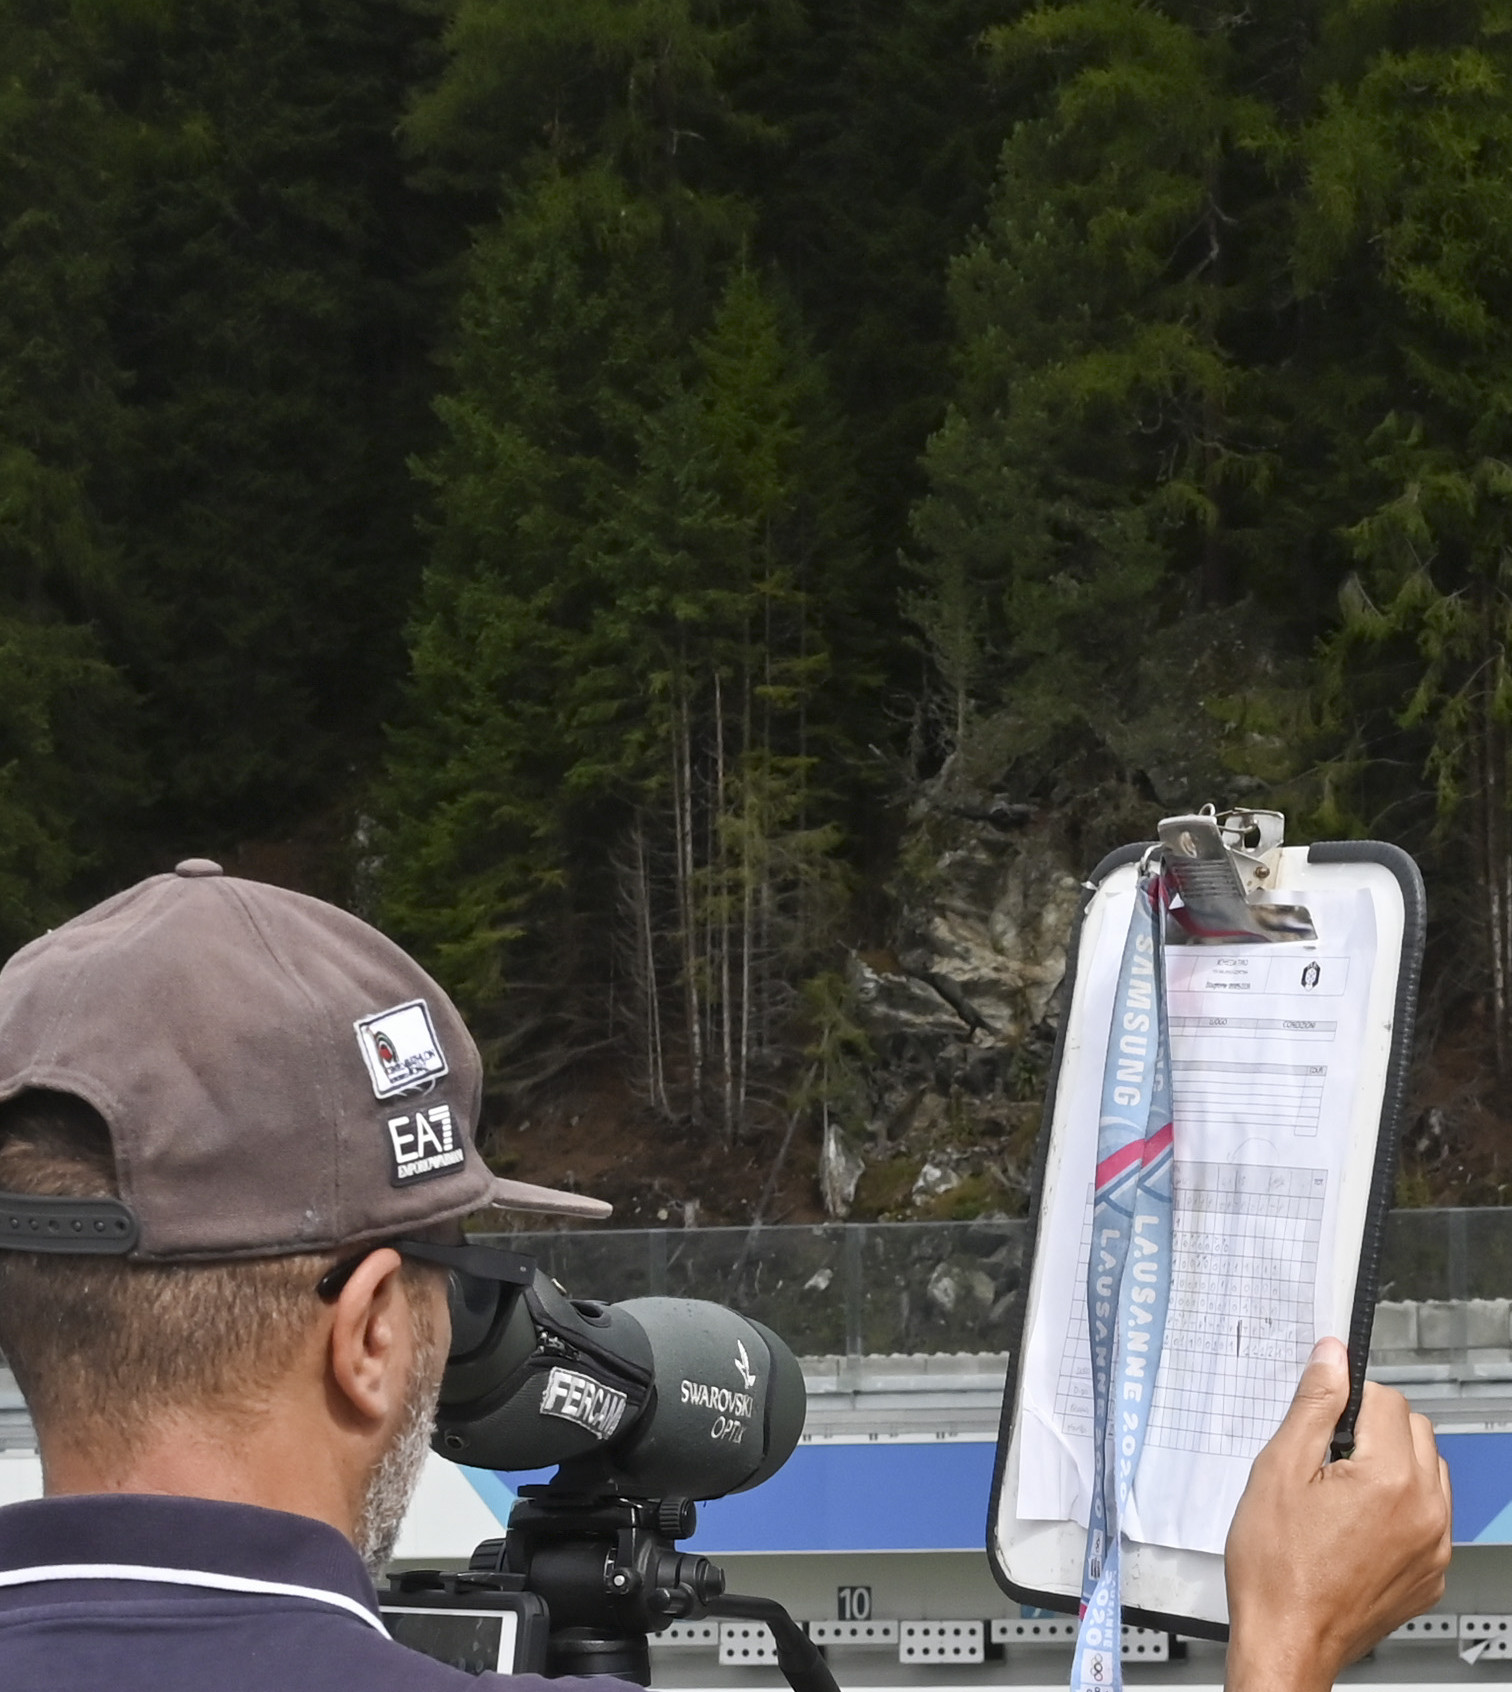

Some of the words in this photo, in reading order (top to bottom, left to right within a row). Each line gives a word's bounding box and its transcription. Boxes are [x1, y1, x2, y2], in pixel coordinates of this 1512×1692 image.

[1114, 934, 1155, 1107] SAMSUNG
[388, 1104, 453, 1164] EA7
[1122, 1215, 1160, 1403] LAUSANNE
[545, 1371, 627, 1437] FERCAM
[681, 1379, 754, 1418] SWAROVSKI
[839, 1587, 871, 1620] 10
